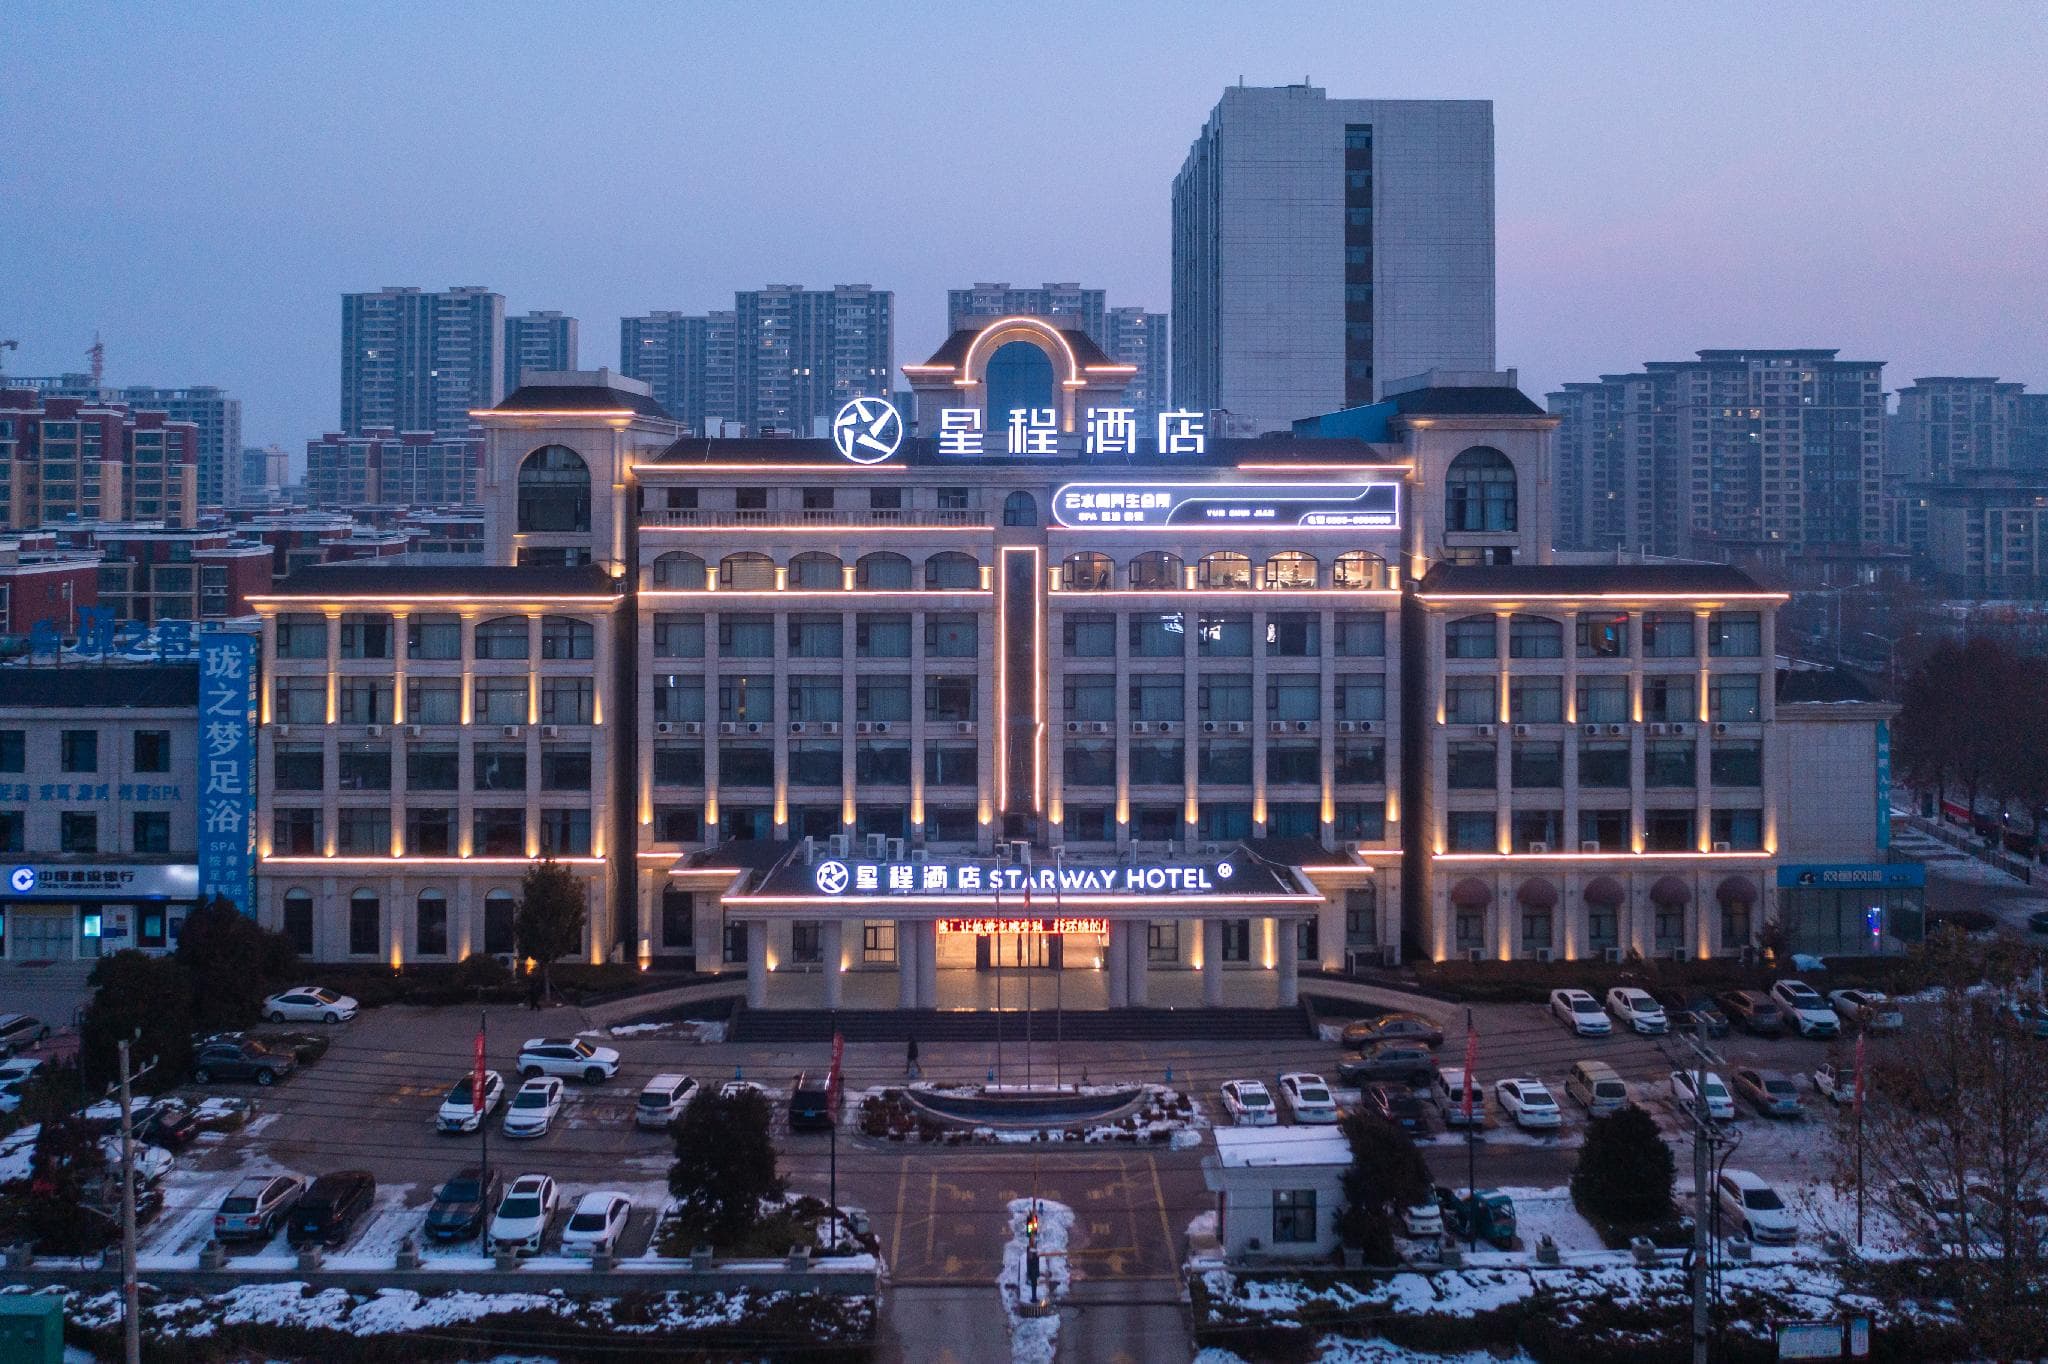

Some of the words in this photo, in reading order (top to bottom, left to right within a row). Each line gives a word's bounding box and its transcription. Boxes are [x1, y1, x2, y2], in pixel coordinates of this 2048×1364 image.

[938, 407, 1205, 455] 星程酒店
[205, 644, 243, 834] 珑之梦足浴
[210, 841, 237, 852] SPA
[856, 865, 981, 889] 星程酒店
[989, 868, 1117, 889] STARWAY
[1126, 868, 1212, 889] HOTEL
